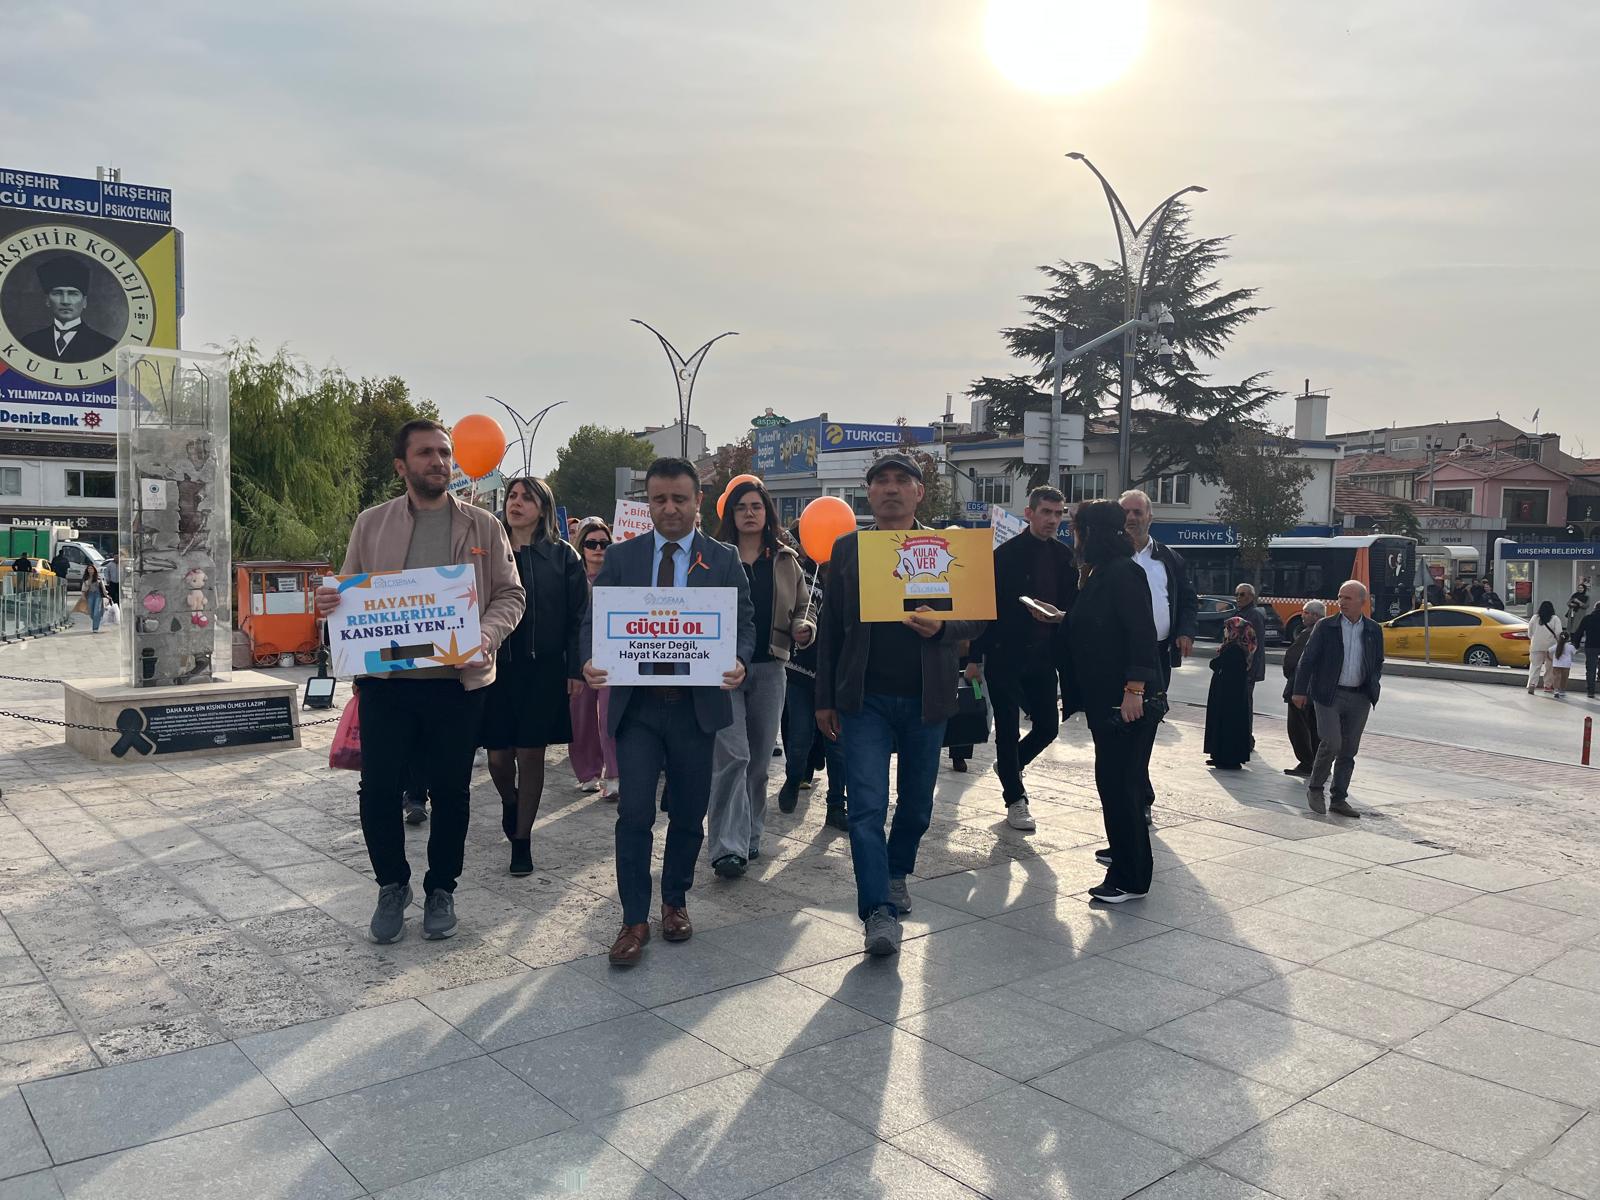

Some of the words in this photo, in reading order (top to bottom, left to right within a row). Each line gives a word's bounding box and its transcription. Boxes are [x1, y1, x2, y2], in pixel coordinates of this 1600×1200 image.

[33, 194, 99, 213] KURSU
[0, 227, 77, 276] RŞEHİR
[85, 238, 149, 301] KOLEJİ
[7, 388, 63, 402] YILIMIZDA
[64, 392, 80, 403] DA
[0, 409, 79, 426] DenizBank
[11, 517, 74, 528] DenizBank
[1177, 529, 1223, 541] TÜRKİYE
[912, 547, 938, 558] KULAK
[1517, 547, 1550, 555] KIRŞEHİR
[1551, 547, 1594, 555] BELEDİYESİ
[916, 557, 936, 569] VER
[364, 593, 436, 612] HAYATIN
[346, 605, 456, 627] RENKLERİYLE
[340, 620, 410, 641] KANSERİ
[625, 618, 680, 638] GÜÇLÜ
[682, 621, 704, 635] OL
[629, 640, 666, 650] Kanser
[668, 640, 698, 651] Değil,
[619, 650, 650, 661] Hayat
[652, 650, 710, 660] Kazanacak
